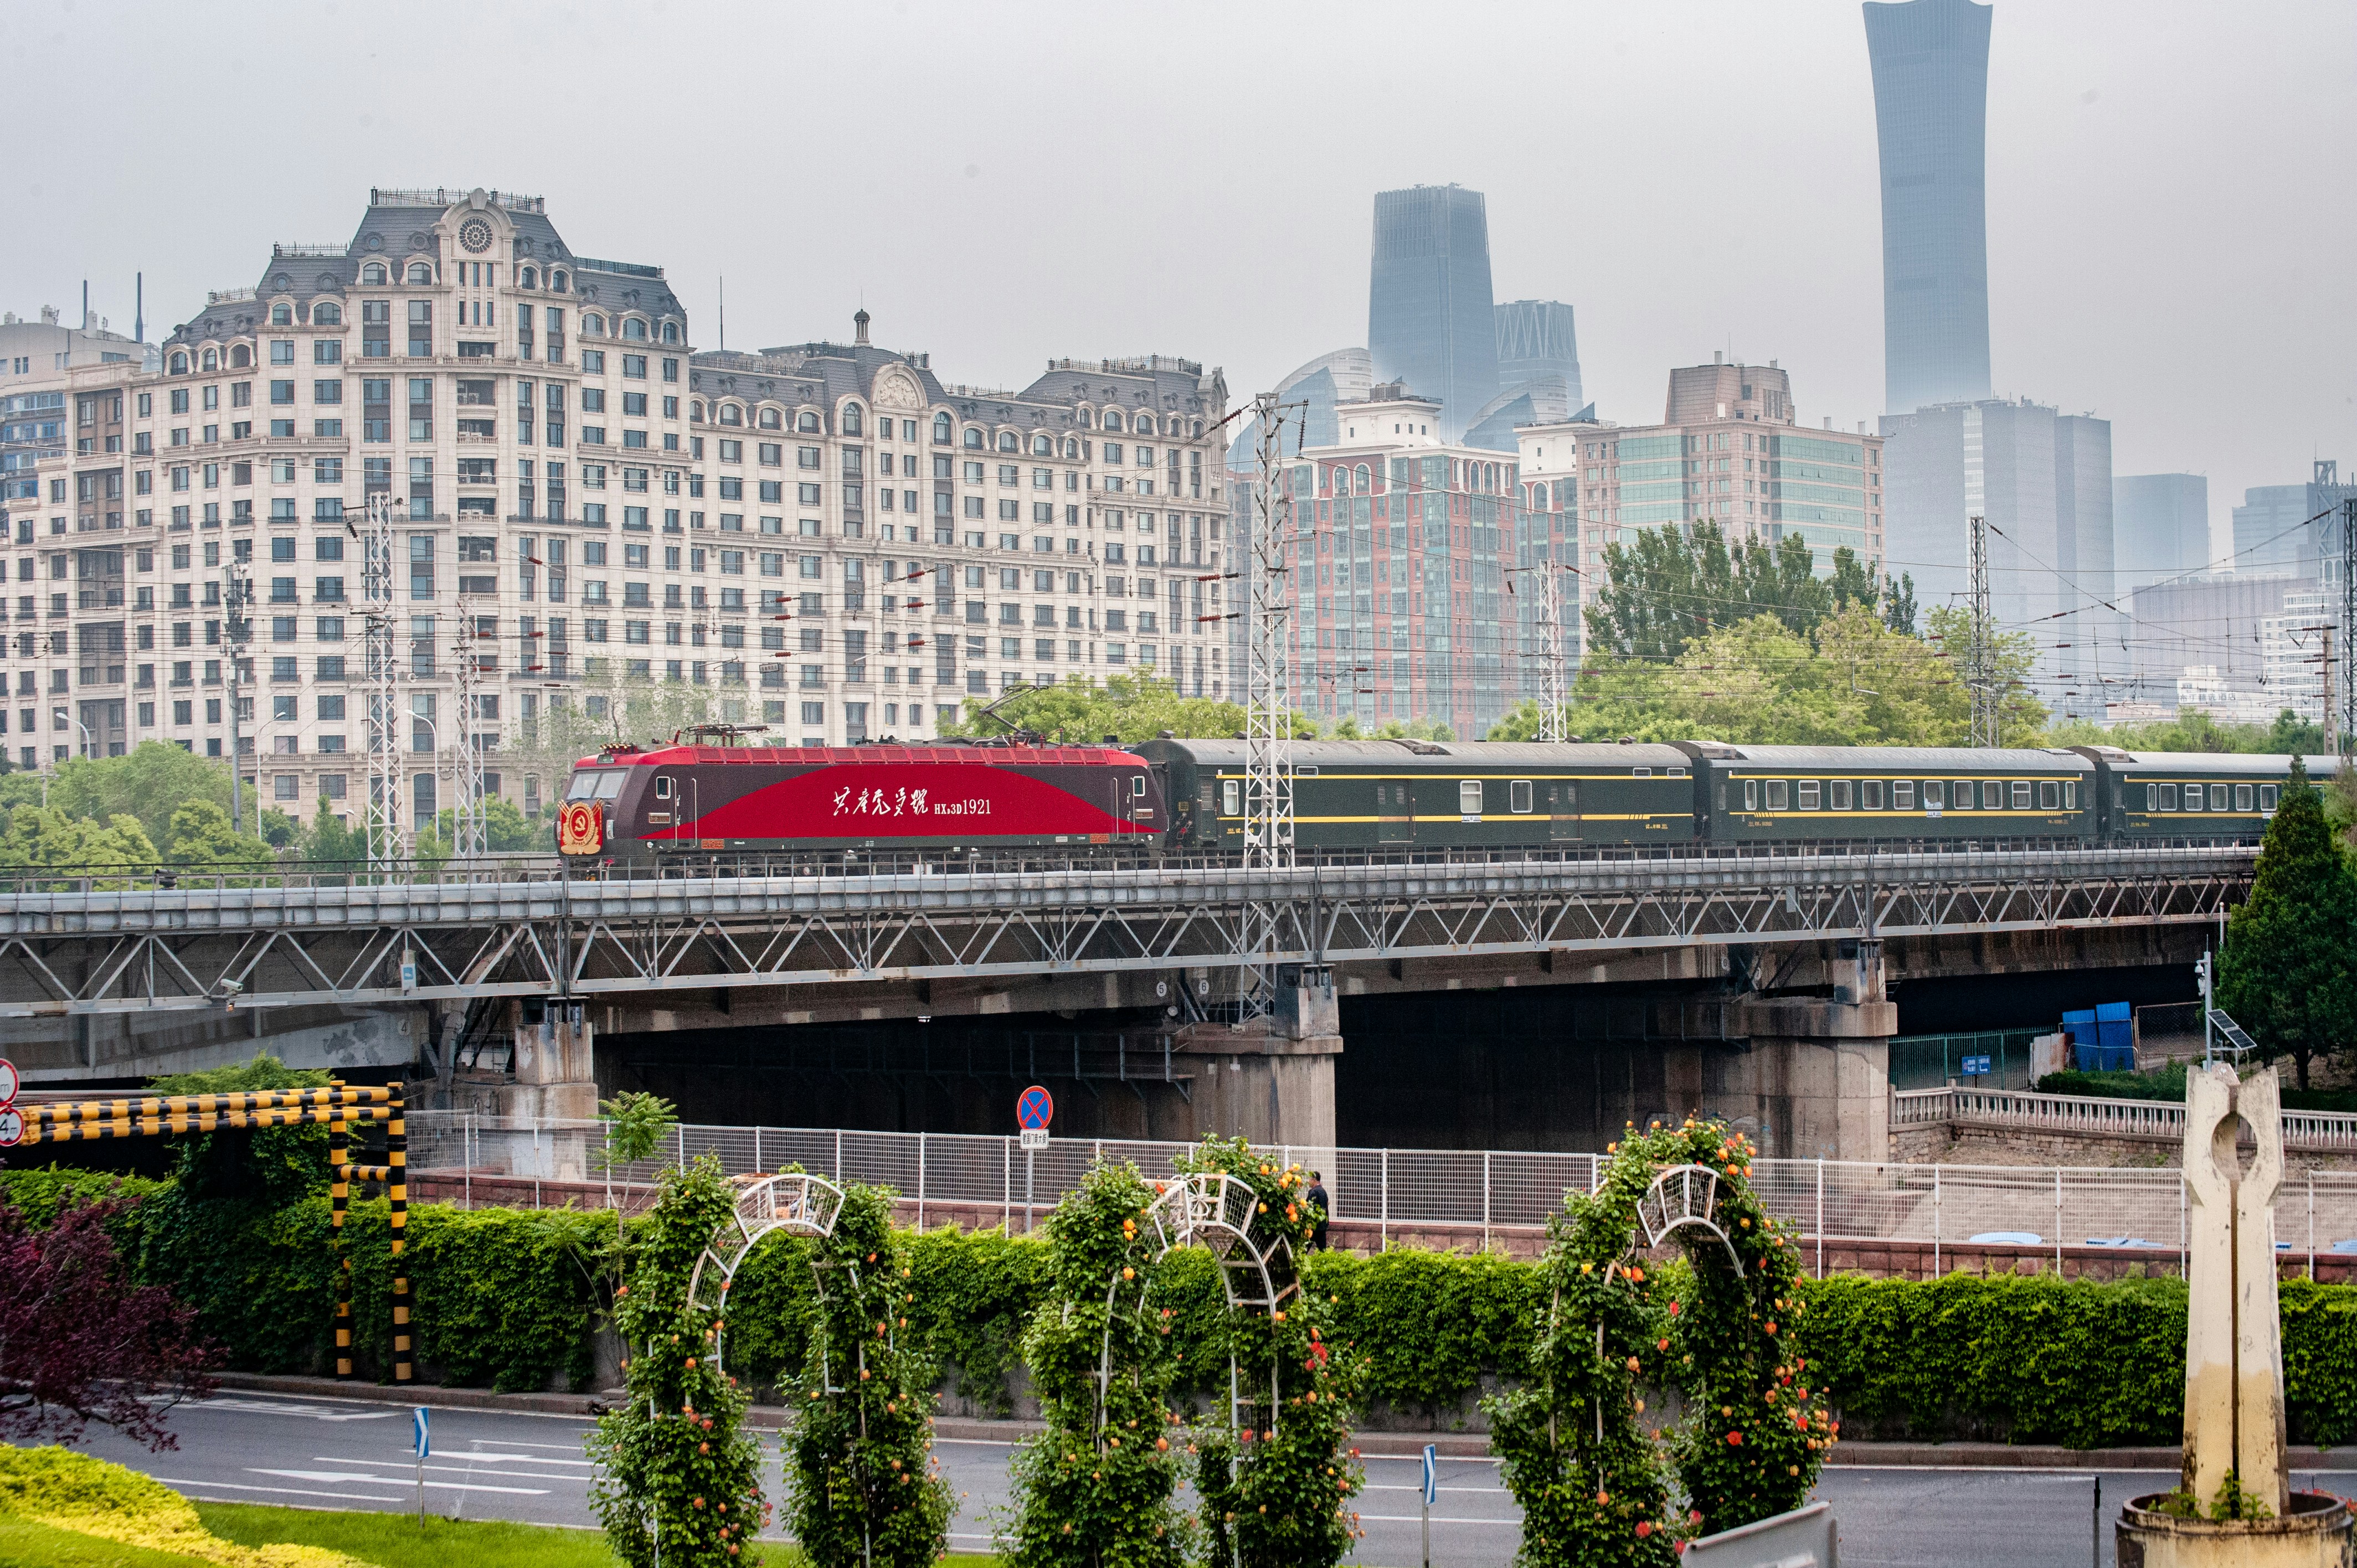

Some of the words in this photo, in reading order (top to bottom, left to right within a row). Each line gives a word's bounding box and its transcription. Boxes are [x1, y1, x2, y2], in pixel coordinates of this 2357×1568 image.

[1899, 416, 1918, 429] IFC
[934, 799, 991, 814] HXD3D1921
[1159, 984, 1164, 994] 5
[1201, 982, 1206, 992] 6
[402, 1022, 406, 1032] 4
[1022, 1133, 1047, 1144] 建国门南大街
